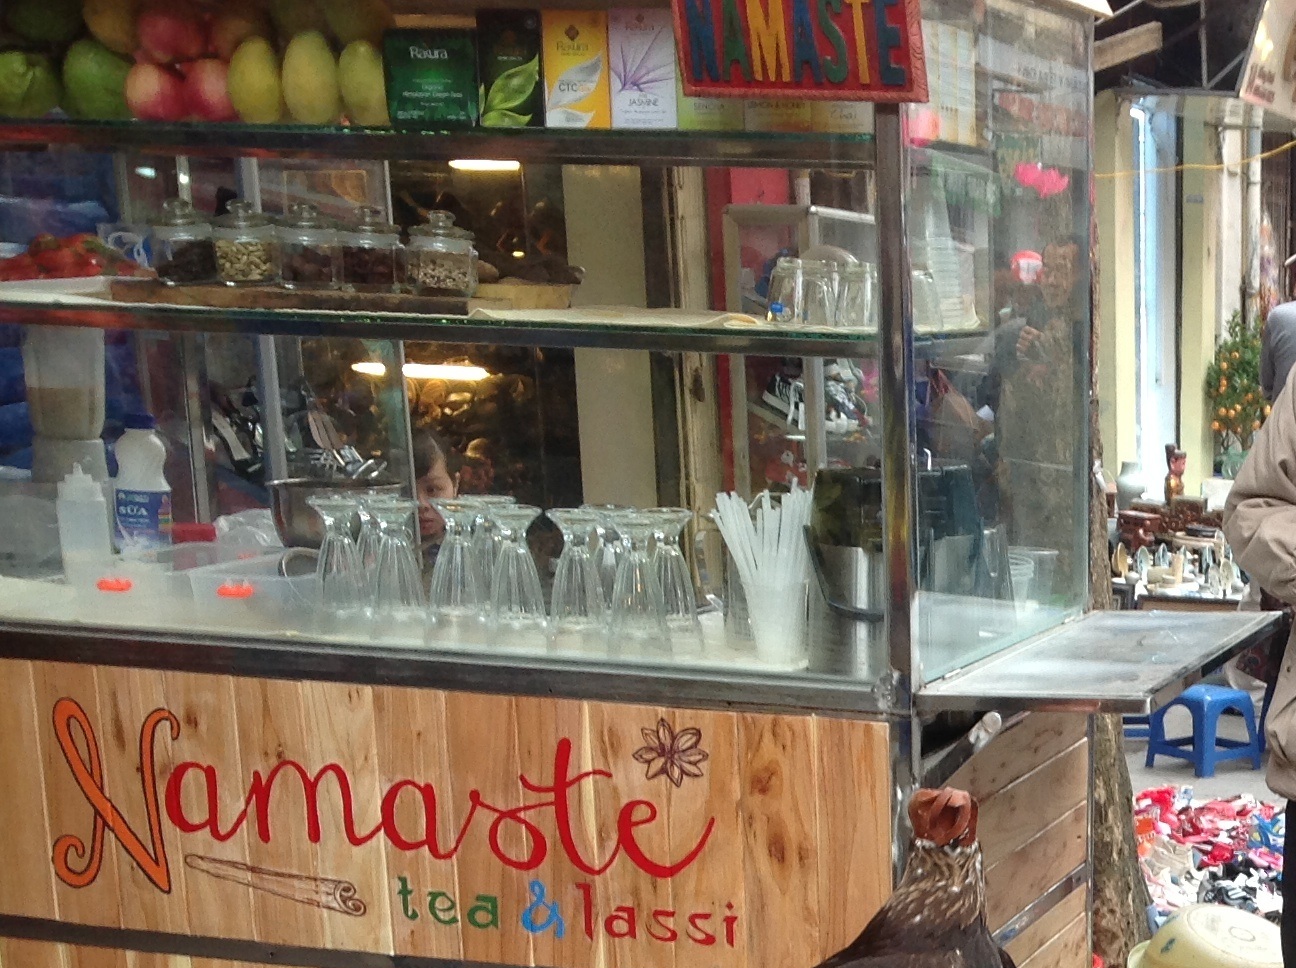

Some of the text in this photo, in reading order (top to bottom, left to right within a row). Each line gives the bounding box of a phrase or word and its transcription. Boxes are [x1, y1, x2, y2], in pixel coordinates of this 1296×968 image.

[686, 0, 906, 86] NAMASTE
[51, 697, 716, 894] Namaste
[397, 876, 739, 948] tea & lassi
